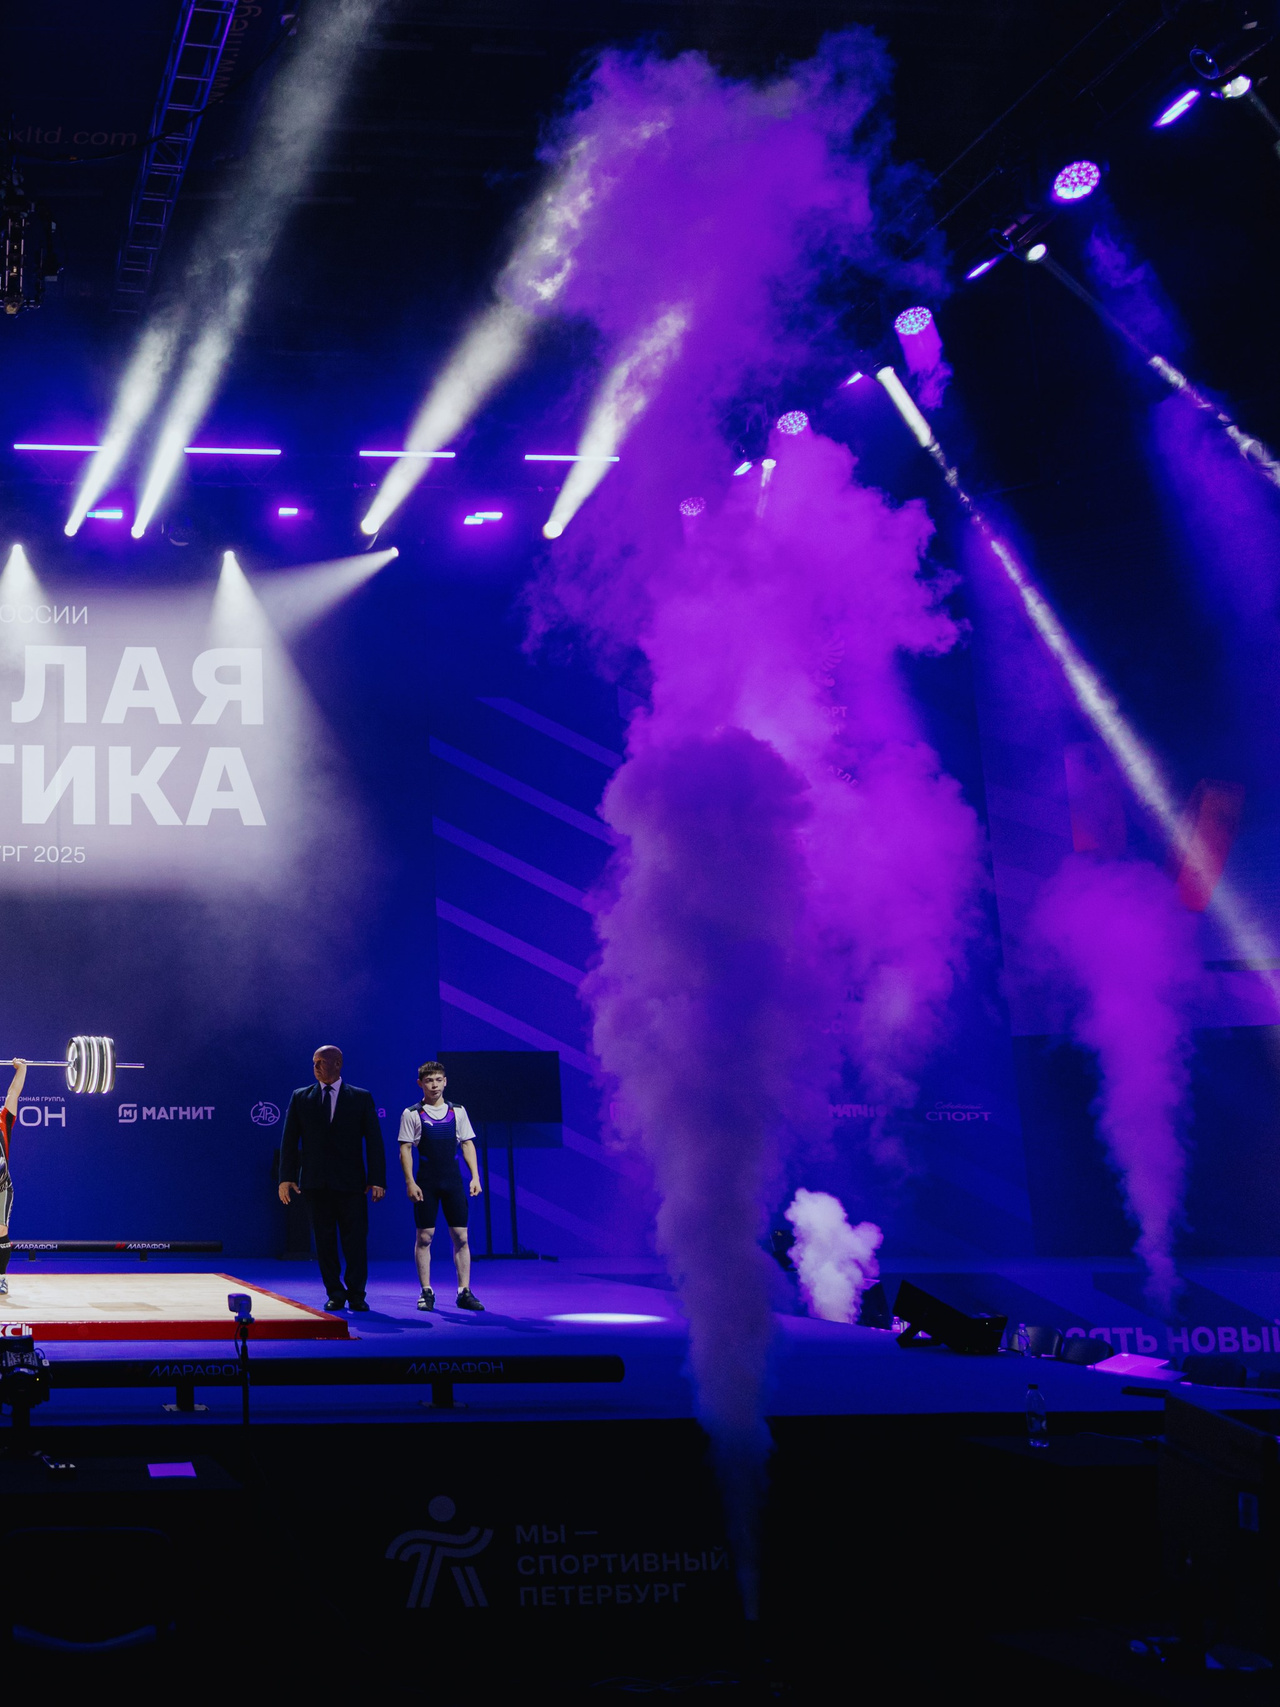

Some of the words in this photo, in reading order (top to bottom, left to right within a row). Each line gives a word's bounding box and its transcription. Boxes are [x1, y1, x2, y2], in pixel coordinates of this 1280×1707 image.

[33, 845, 87, 864] 2025
[142, 1106, 216, 1120] МАГНИТ
[925, 1111, 993, 1122] СПОРТ
[406, 1361, 504, 1375] МАРАФОН
[515, 1524, 567, 1544] МЫ
[517, 1546, 731, 1576] СПОРТИВНЫЙ
[519, 1582, 687, 1607] ПЕТЕРБУРГ
